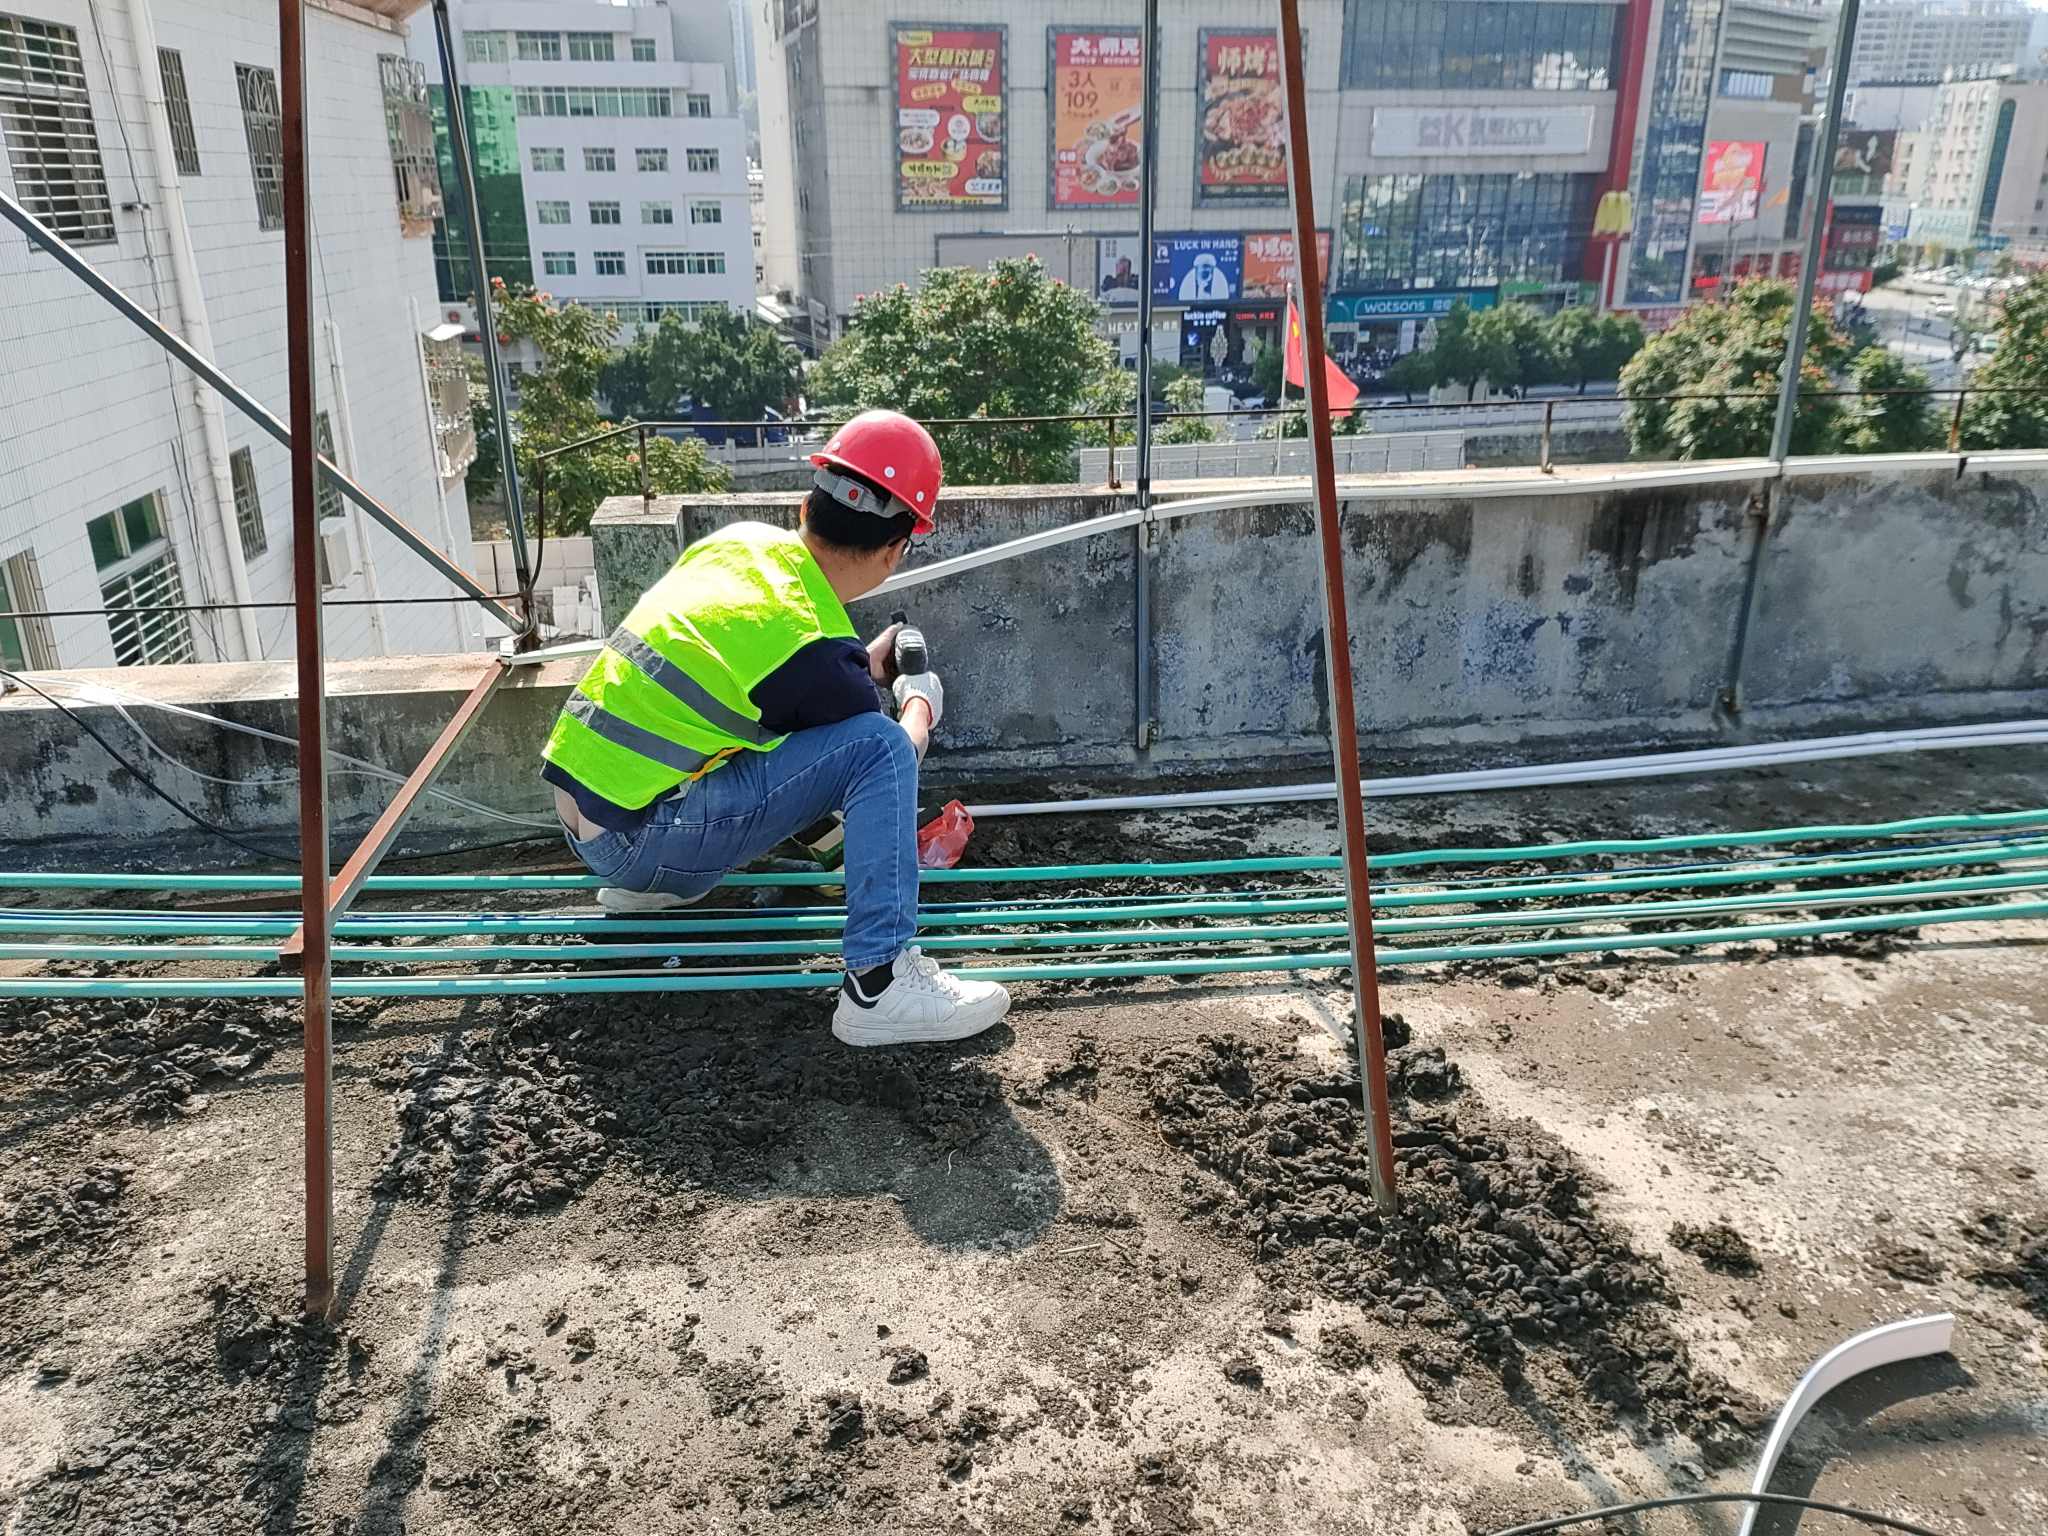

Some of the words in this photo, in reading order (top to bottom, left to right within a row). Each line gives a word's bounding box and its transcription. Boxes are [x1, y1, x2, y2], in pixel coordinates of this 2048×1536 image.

[1063, 91, 1099, 109] 109
[1174, 239, 1199, 250] LUCK
[1200, 239, 1211, 249] IN
[1212, 238, 1239, 249] HAND
[1364, 300, 1425, 314] watsons
